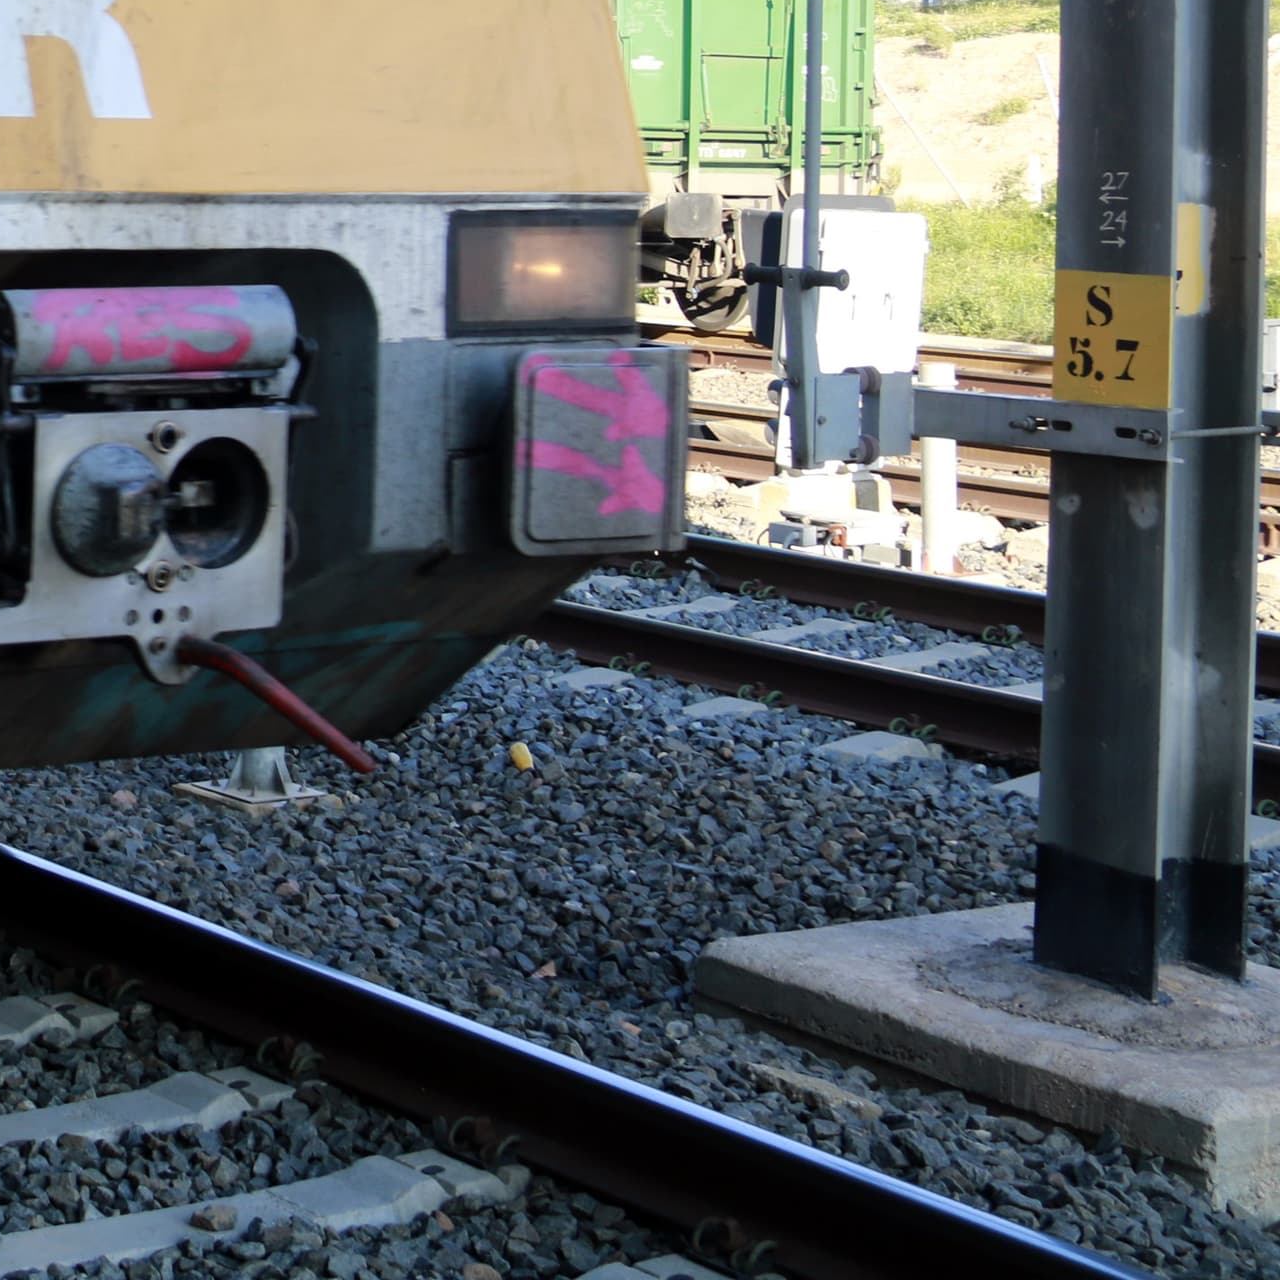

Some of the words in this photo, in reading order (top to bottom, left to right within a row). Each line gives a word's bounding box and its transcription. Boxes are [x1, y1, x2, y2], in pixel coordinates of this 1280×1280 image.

[1101, 171, 1130, 192] 27
[1099, 210, 1128, 232] 24
[1086, 285, 1114, 327] S
[1066, 336, 1140, 382] 5.7
